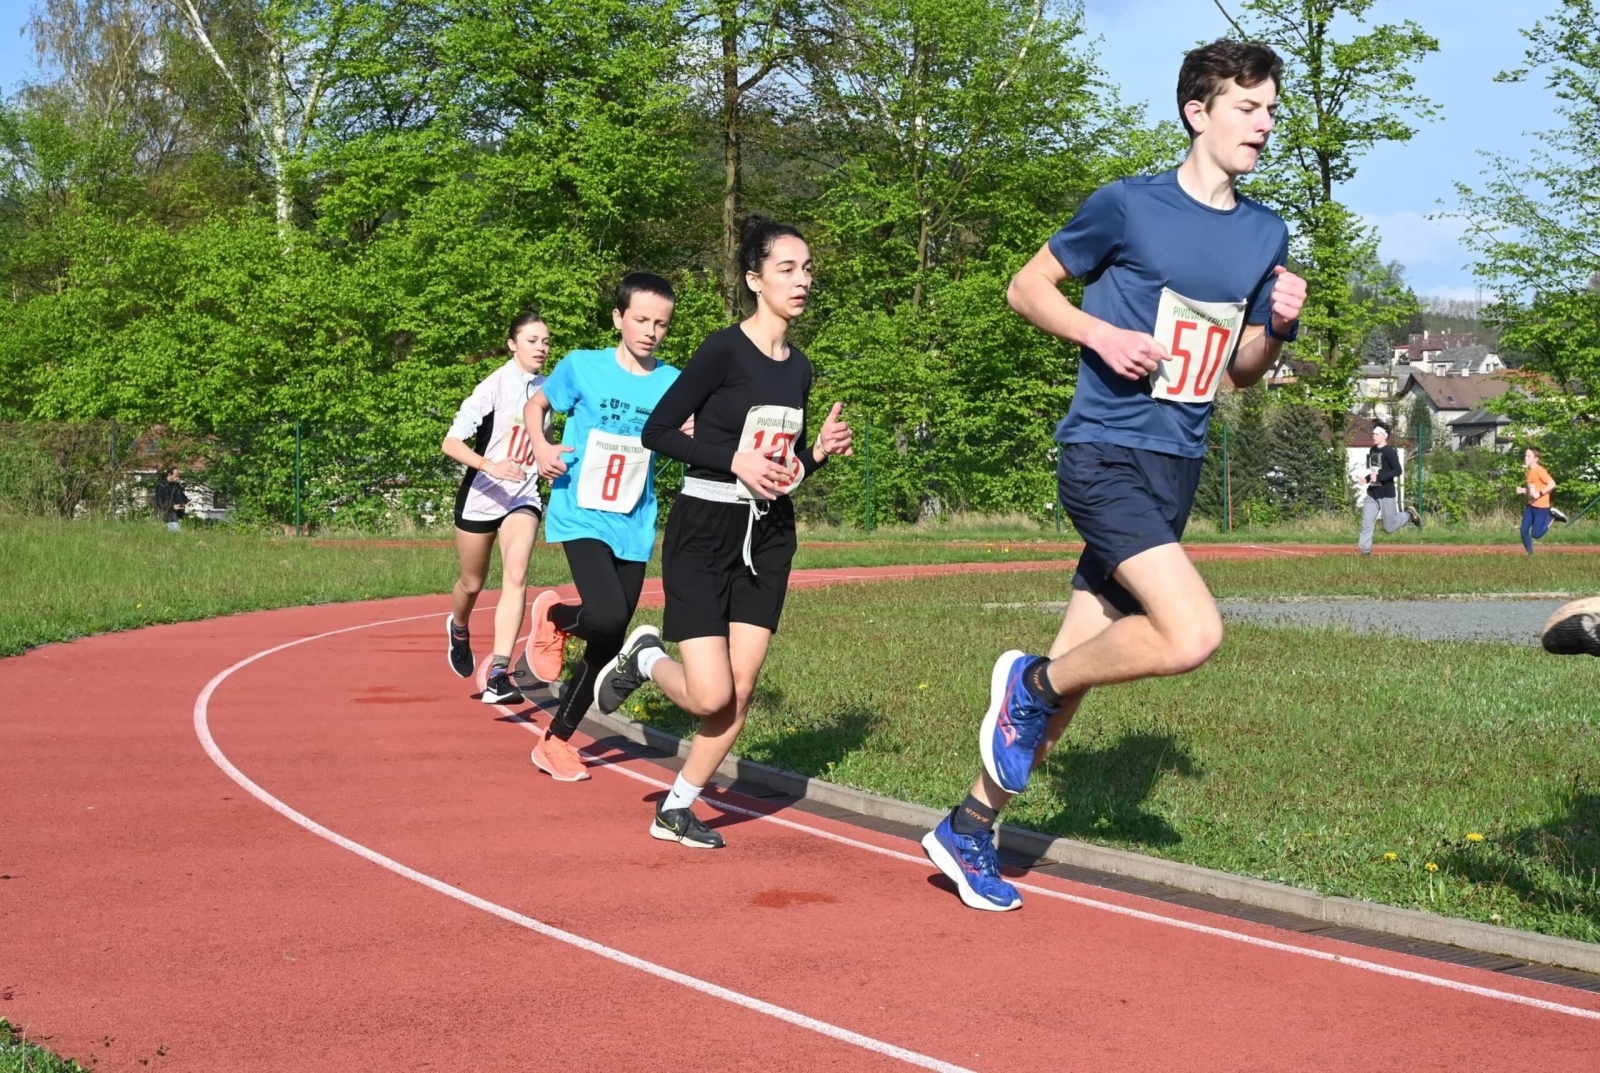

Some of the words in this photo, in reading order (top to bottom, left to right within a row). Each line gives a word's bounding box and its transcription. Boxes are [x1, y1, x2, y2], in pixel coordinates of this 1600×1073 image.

[1167, 320, 1230, 397] 50
[757, 417, 782, 428] PIVOVAR
[596, 440, 619, 452] PIVOVAR
[620, 445, 644, 454] TRUTNOV
[602, 454, 626, 501] 8
